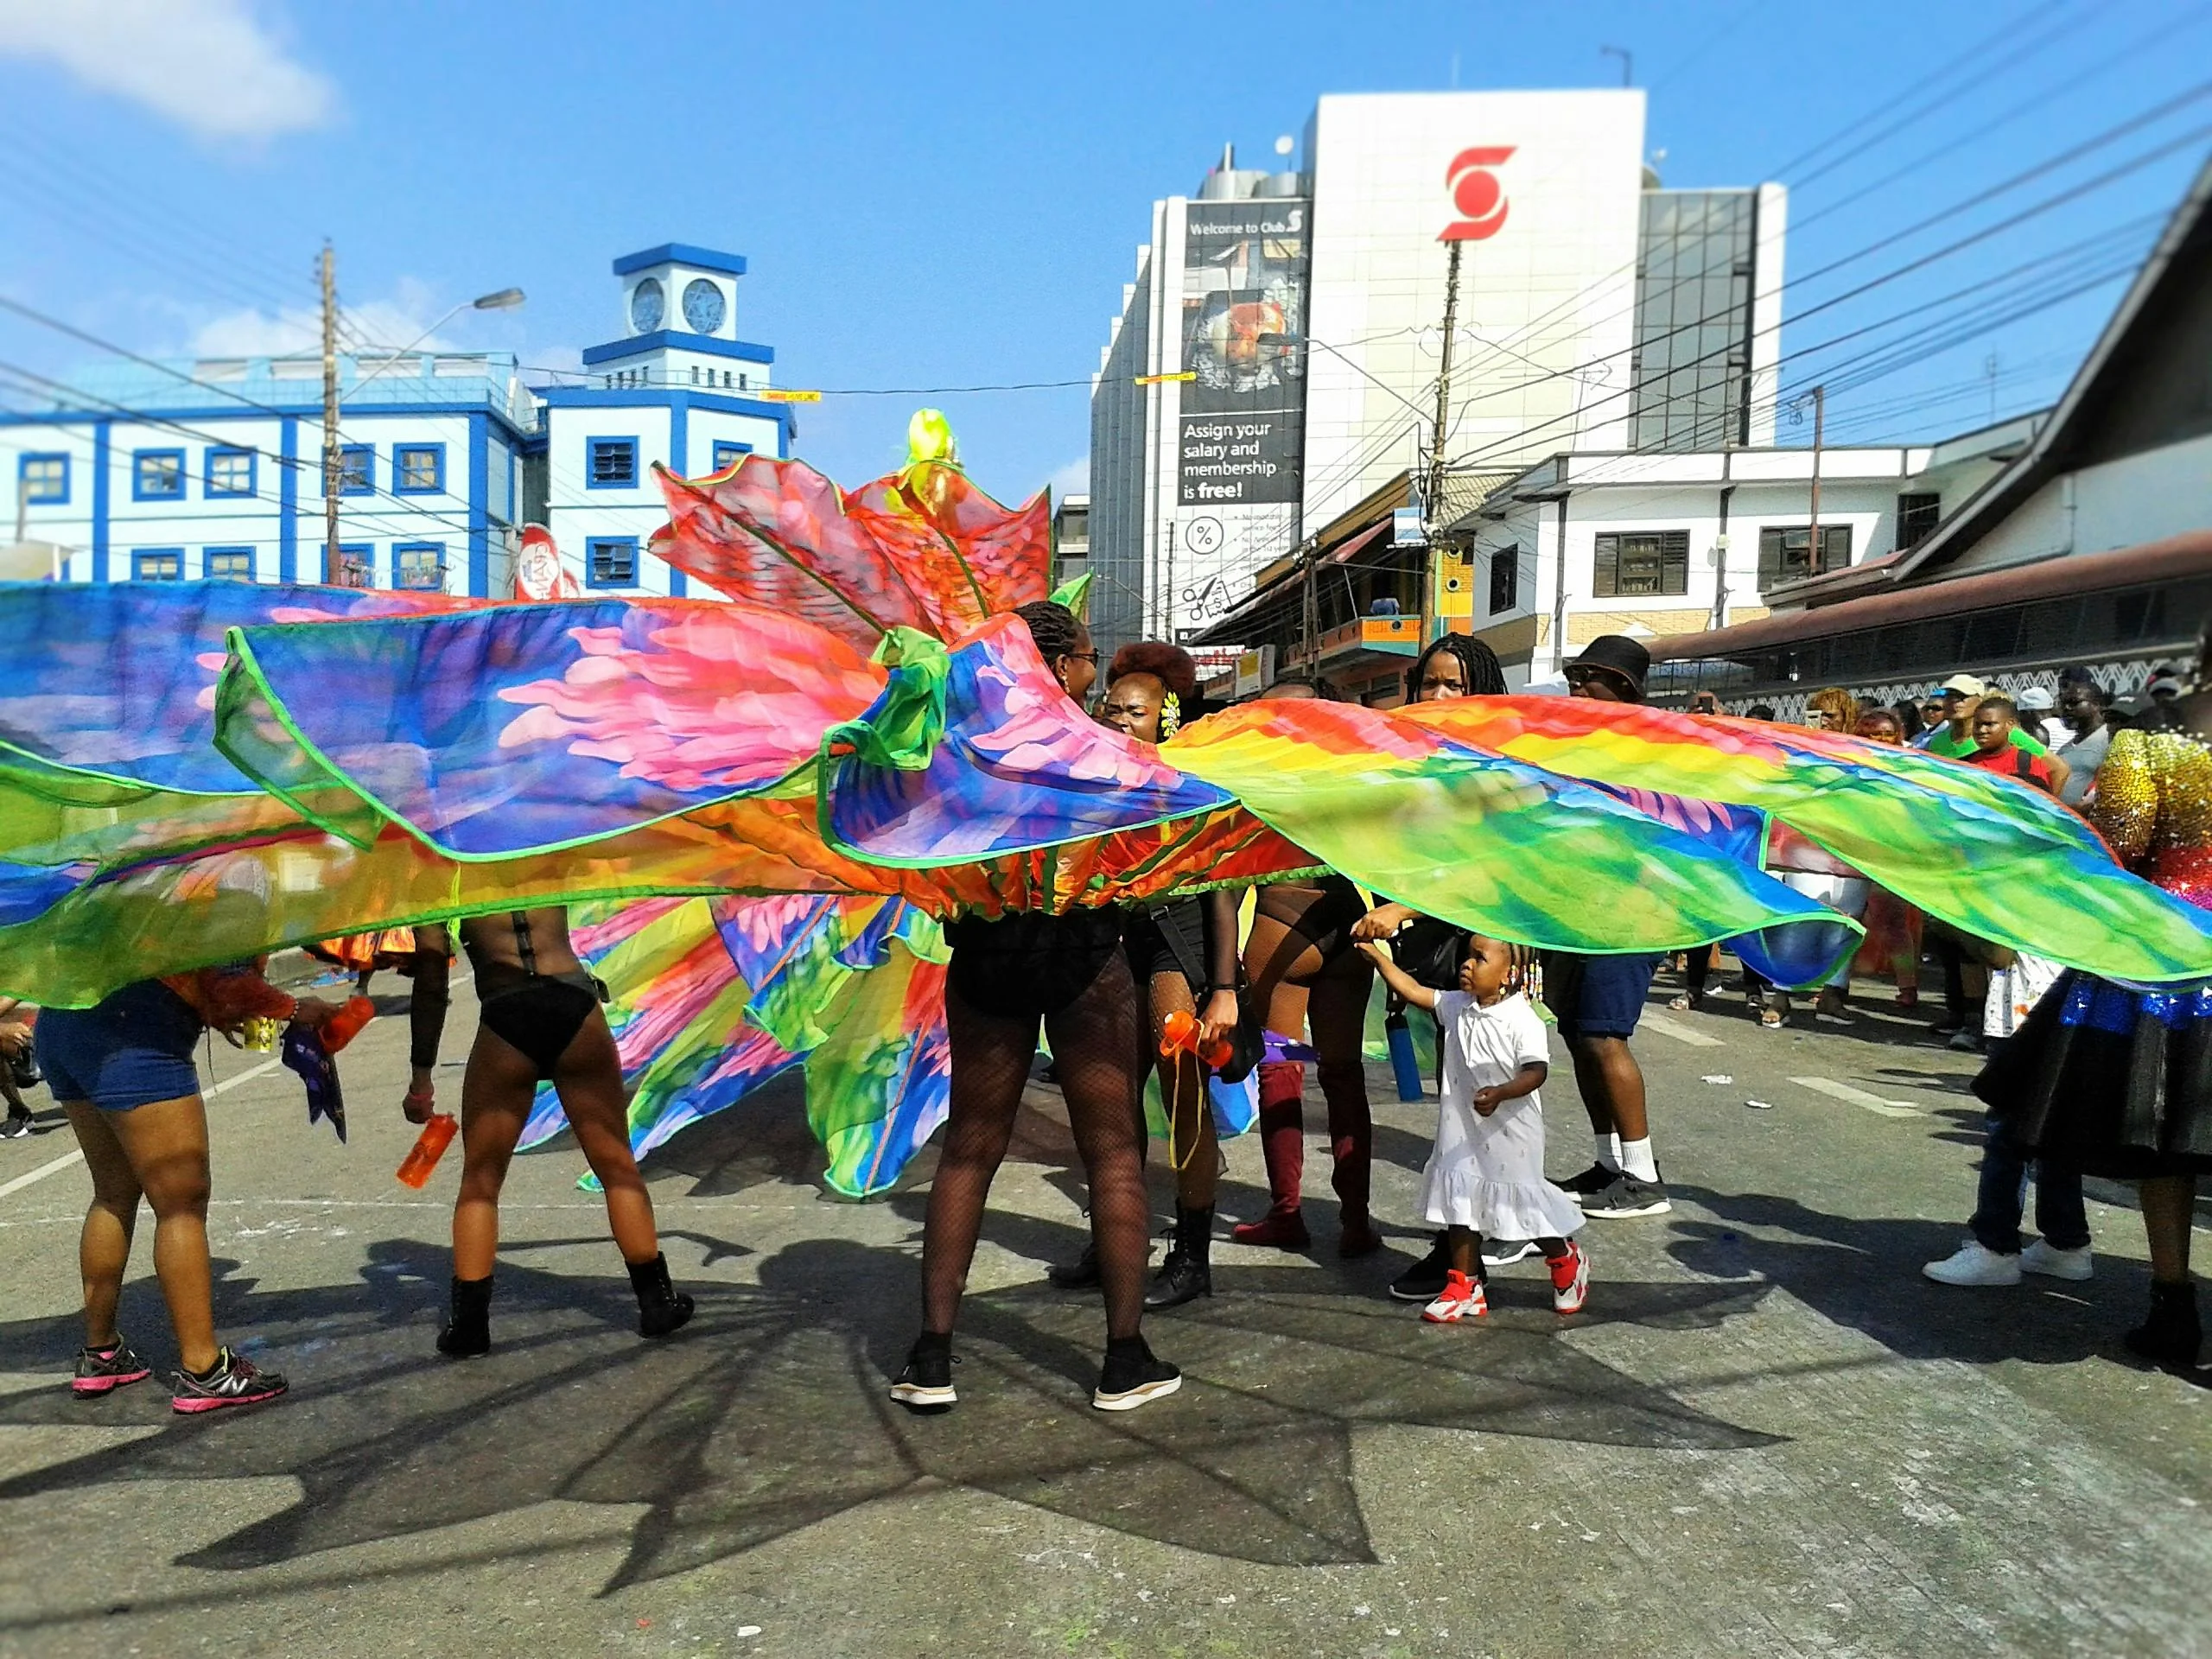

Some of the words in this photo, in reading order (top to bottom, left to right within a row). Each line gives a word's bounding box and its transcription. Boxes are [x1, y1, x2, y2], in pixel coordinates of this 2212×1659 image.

[1190, 222, 1243, 235] Welcome
[1245, 223, 1258, 233] to
[1261, 221, 1285, 233] Club
[1184, 423, 1234, 442] Assign
[1236, 423, 1272, 440] your
[1184, 442, 1228, 460] salary
[1230, 439, 1260, 456] and
[1184, 460, 1277, 478] membership
[1184, 485, 1194, 499] is
[1197, 481, 1243, 499] free!
